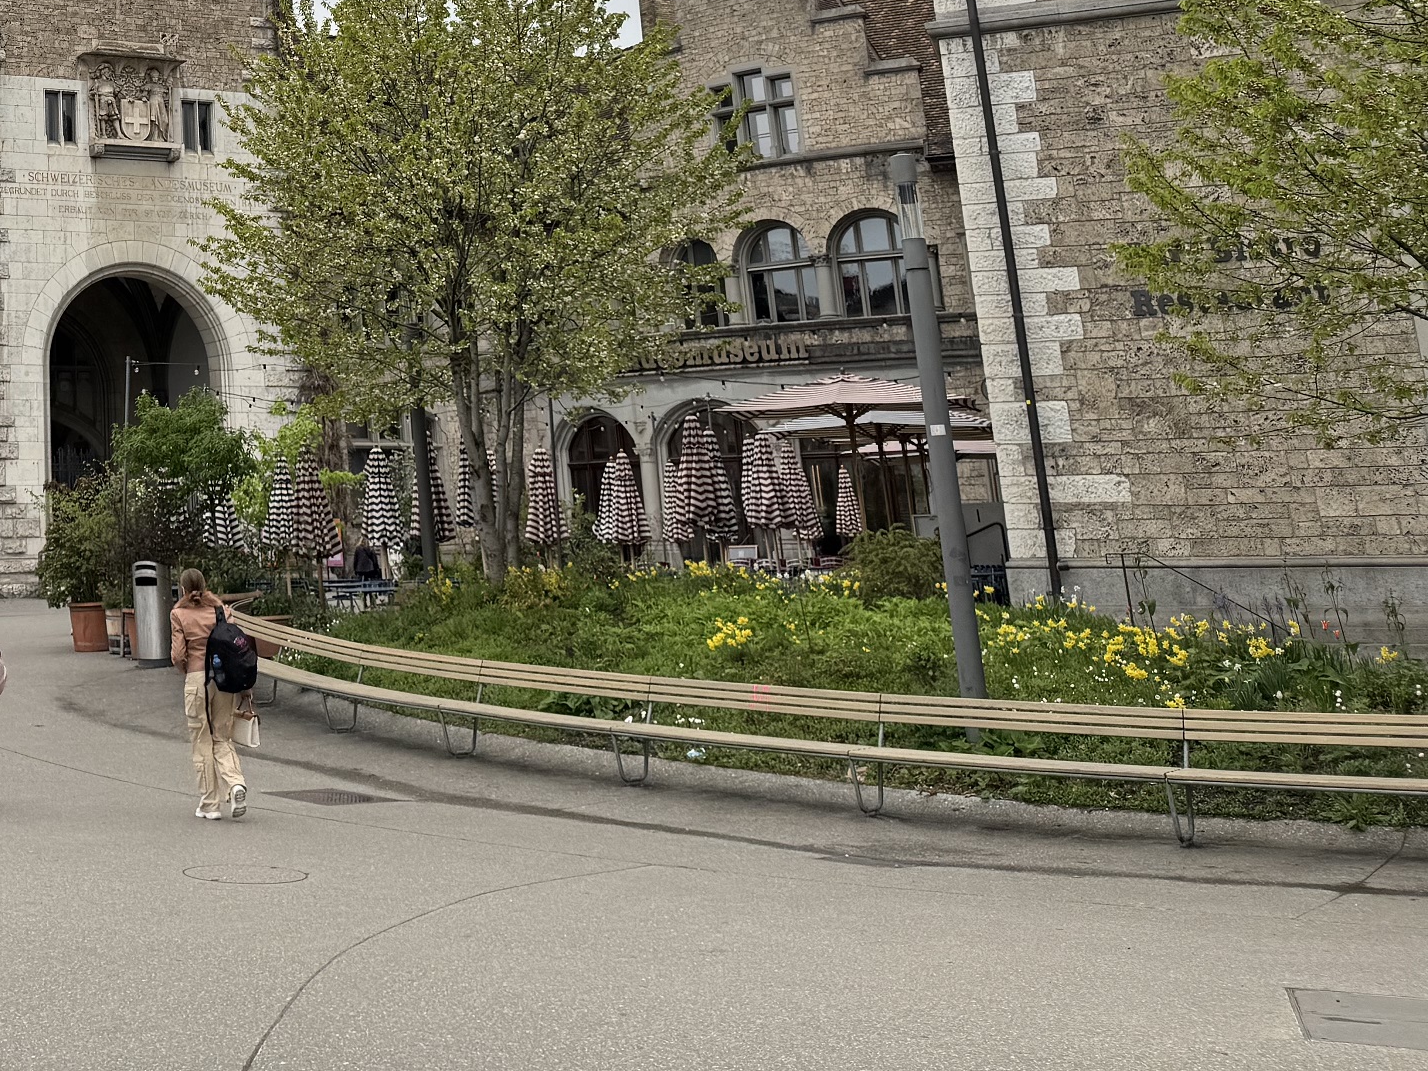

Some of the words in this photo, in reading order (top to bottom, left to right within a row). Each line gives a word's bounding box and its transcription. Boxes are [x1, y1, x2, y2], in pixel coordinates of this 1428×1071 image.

[28, 171, 135, 187] SCHWEIZERISCHES
[50, 188, 79, 198] DURCH
[84, 190, 132, 201] BESCHLUSS
